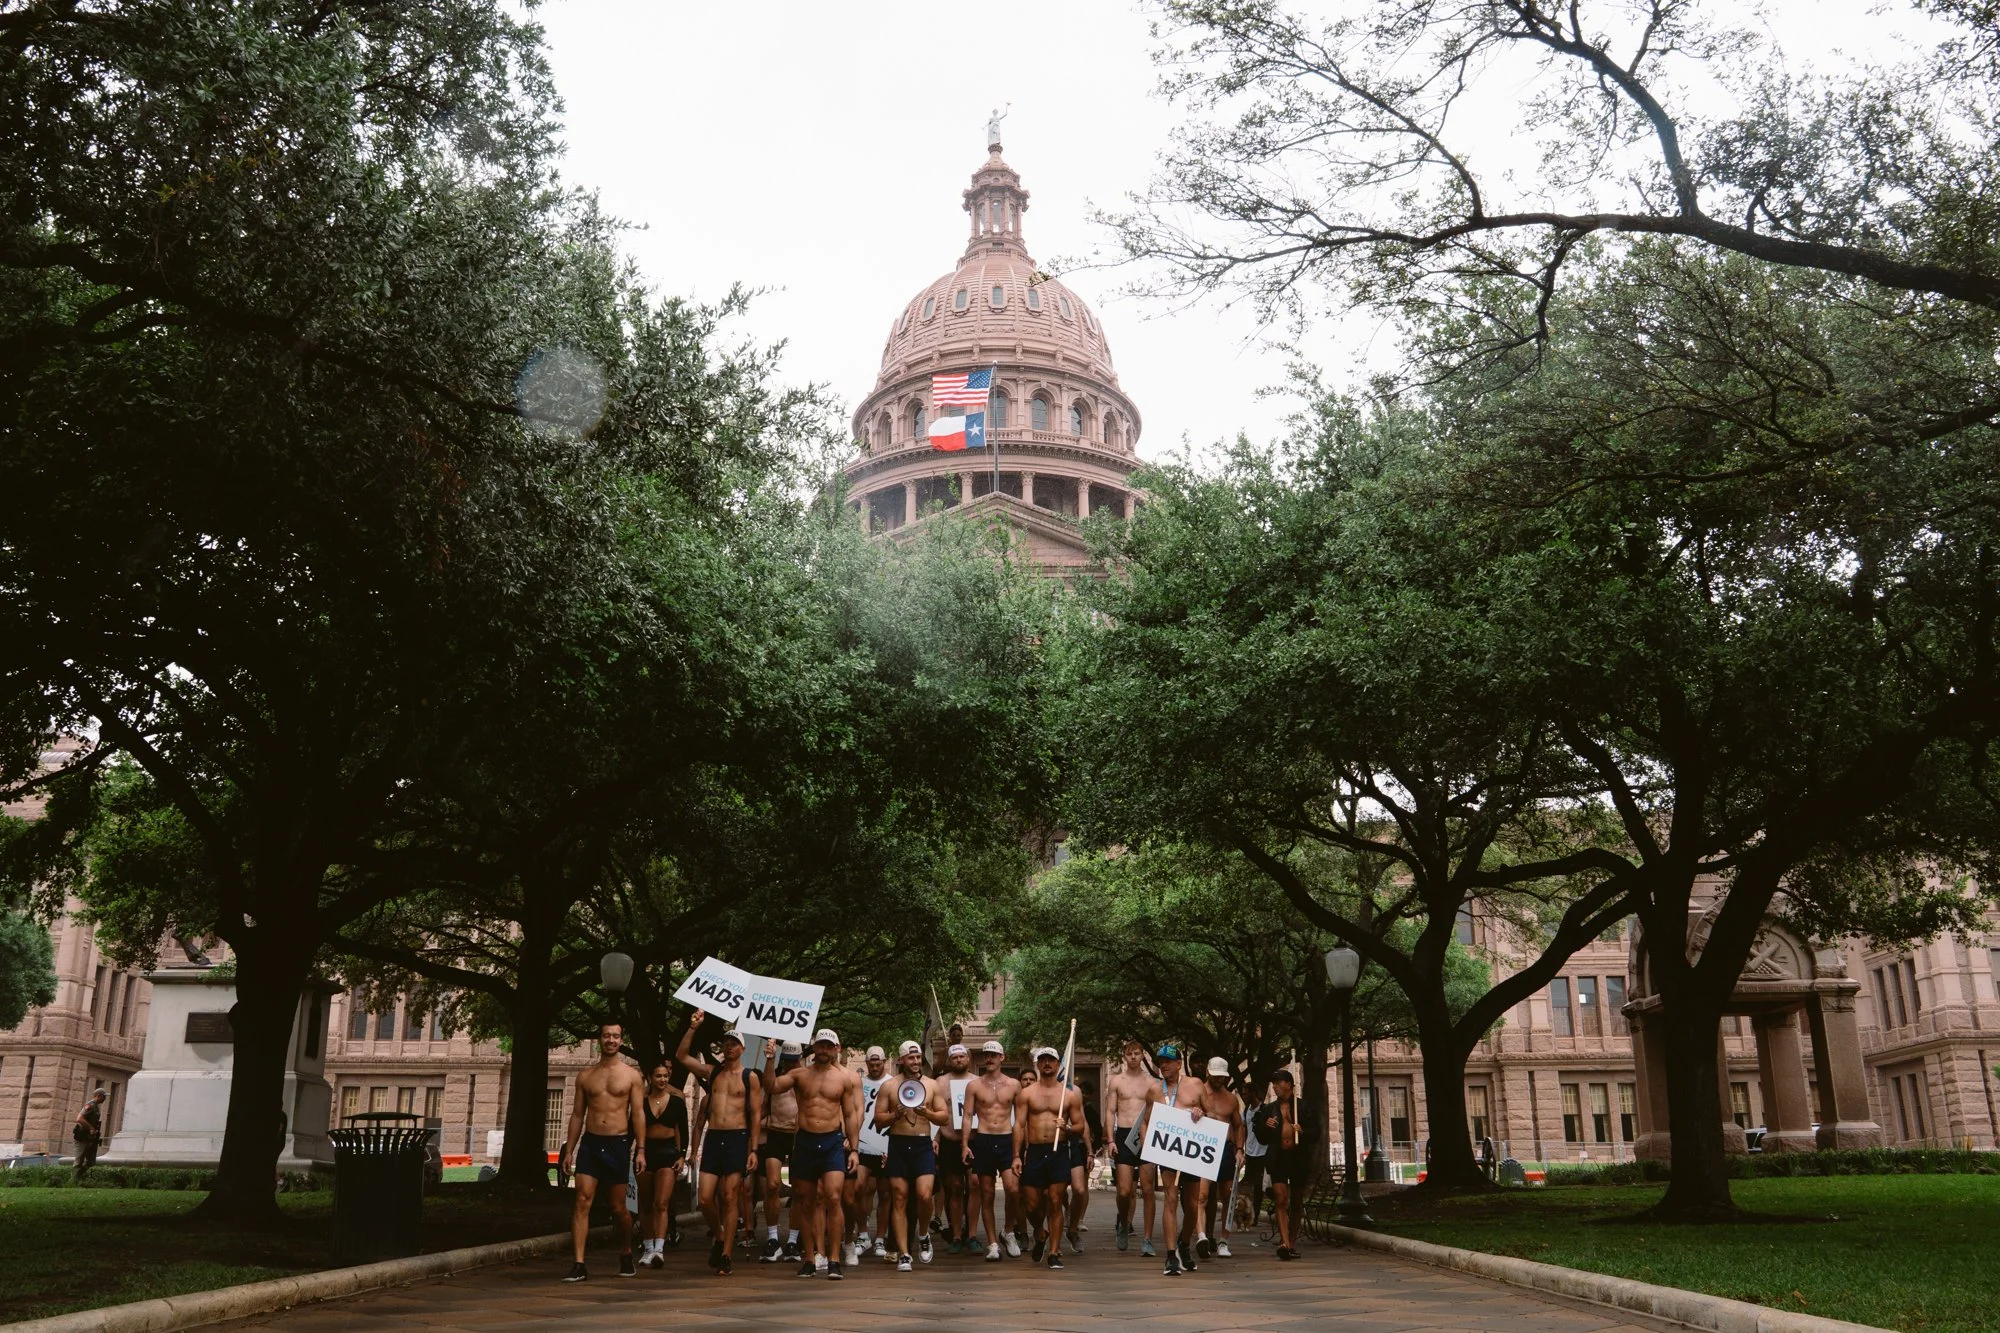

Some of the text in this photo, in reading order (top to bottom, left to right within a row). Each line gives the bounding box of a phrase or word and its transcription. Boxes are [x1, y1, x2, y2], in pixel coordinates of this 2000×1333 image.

[688, 977, 745, 1009] NADS
[699, 970, 746, 994] CHECK YOU
[752, 992, 814, 1010] CHECK YOUR
[746, 1002, 810, 1028] NADS
[1155, 1120, 1190, 1138] CHECK
[1191, 1131, 1219, 1146] YOUR
[1151, 1130, 1216, 1164] NADS
